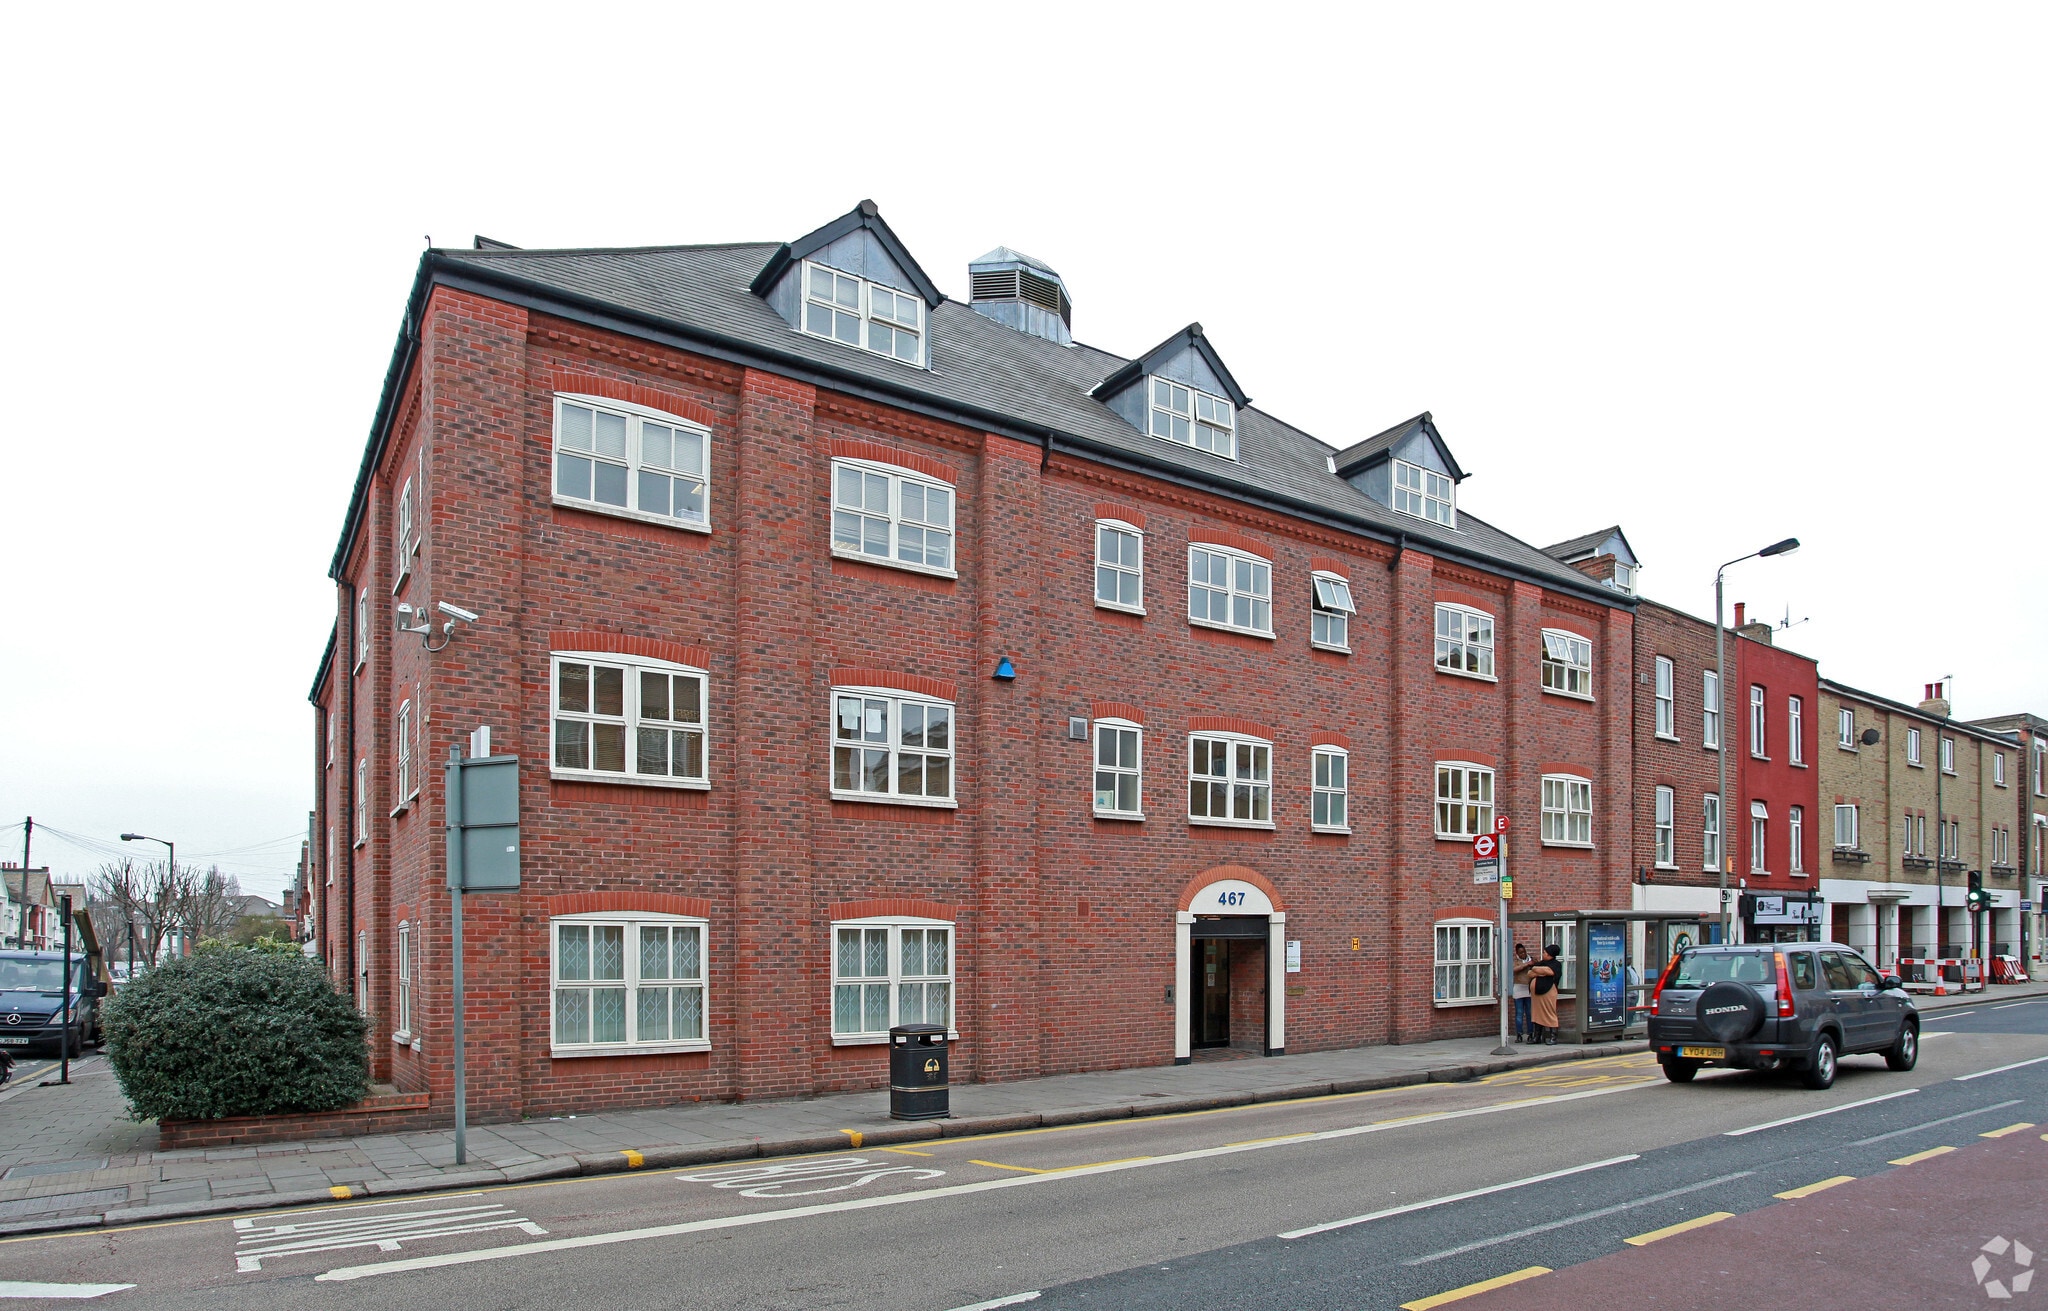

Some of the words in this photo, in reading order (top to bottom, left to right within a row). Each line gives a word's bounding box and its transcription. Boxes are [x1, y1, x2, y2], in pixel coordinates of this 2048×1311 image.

[1497, 818, 1505, 829] E
[1218, 891, 1246, 906] 467
[1705, 1004, 1748, 1015] HONDA
[1683, 1047, 1704, 1056] LY04
[1706, 1048, 1723, 1057] URH
